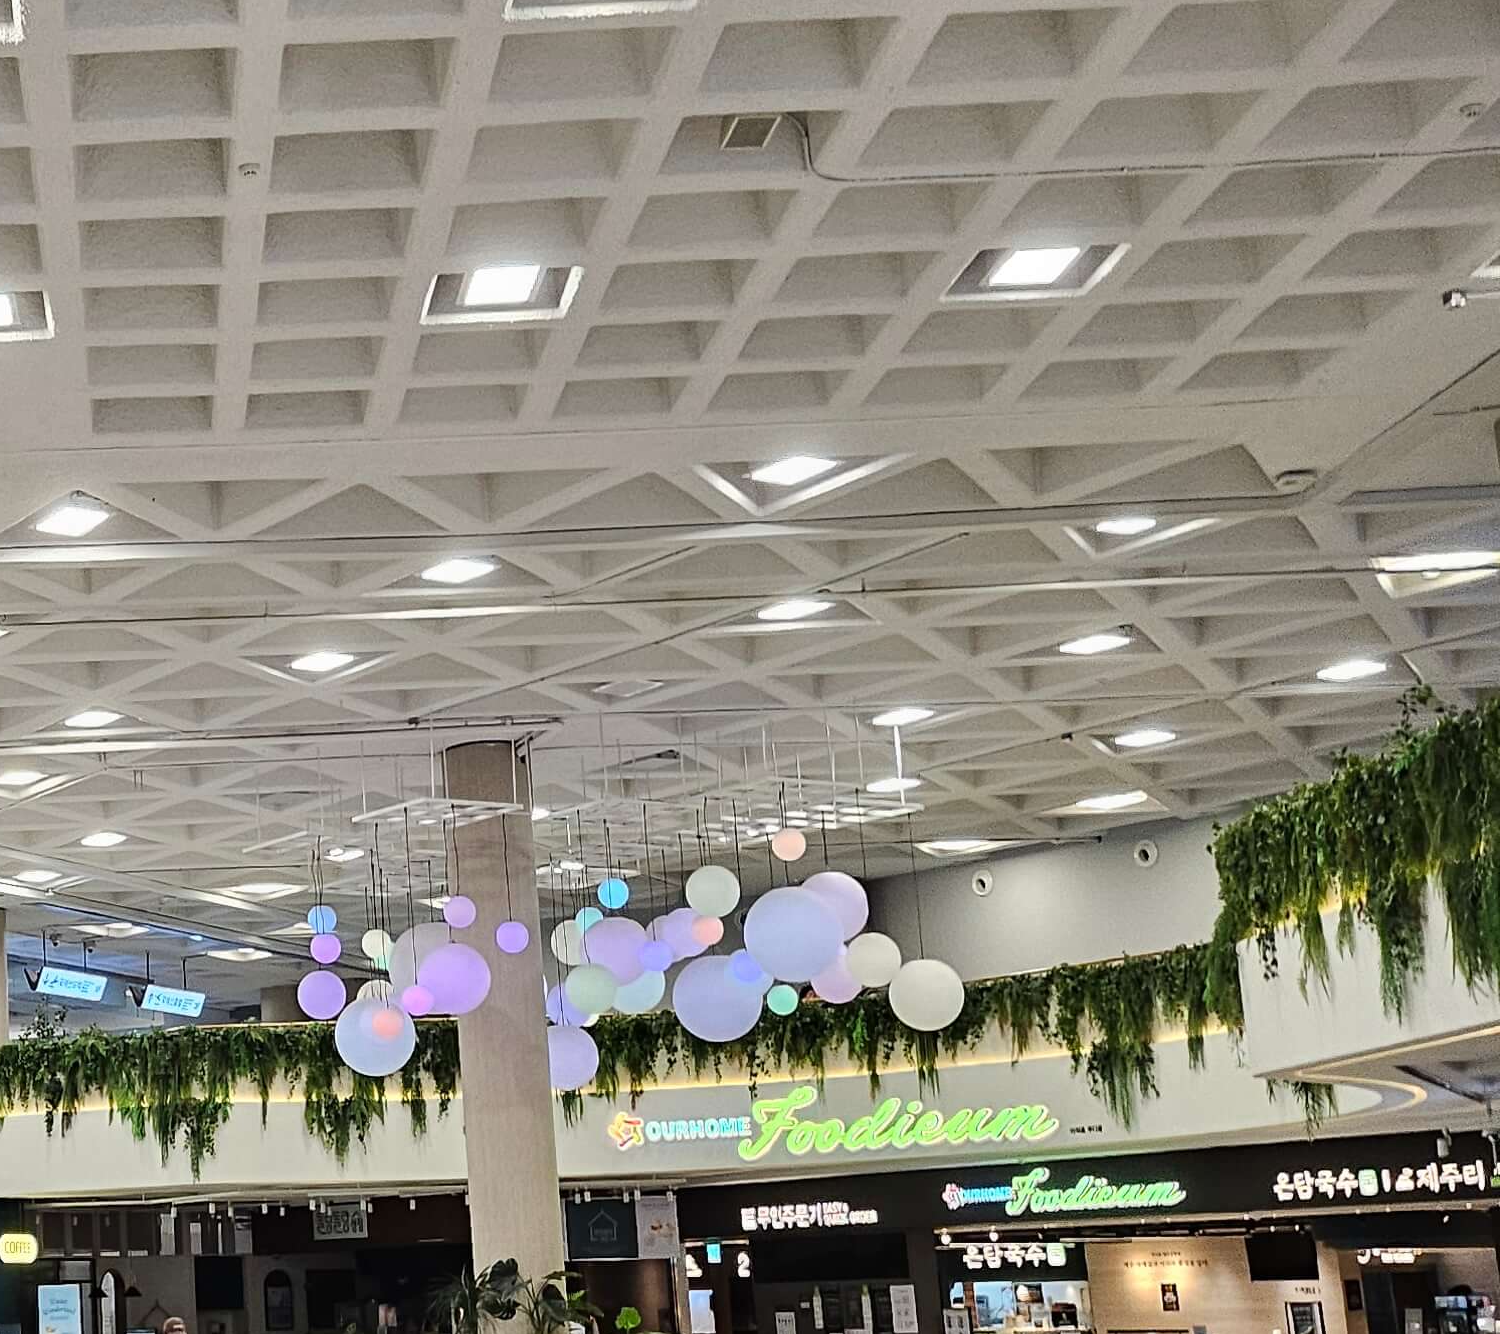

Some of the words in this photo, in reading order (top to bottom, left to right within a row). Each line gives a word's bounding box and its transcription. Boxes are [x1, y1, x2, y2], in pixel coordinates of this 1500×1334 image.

[645, 1117, 752, 1142] OURHOME
[738, 1085, 1060, 1161] Foodieum
[1416, 1159, 1486, 1194] 제주리
[960, 1186, 1014, 1206] OURHOME
[757, 1202, 822, 1230] 무인주문기
[4, 1241, 31, 1254] COFFEE
[737, 1251, 751, 1278] 2
